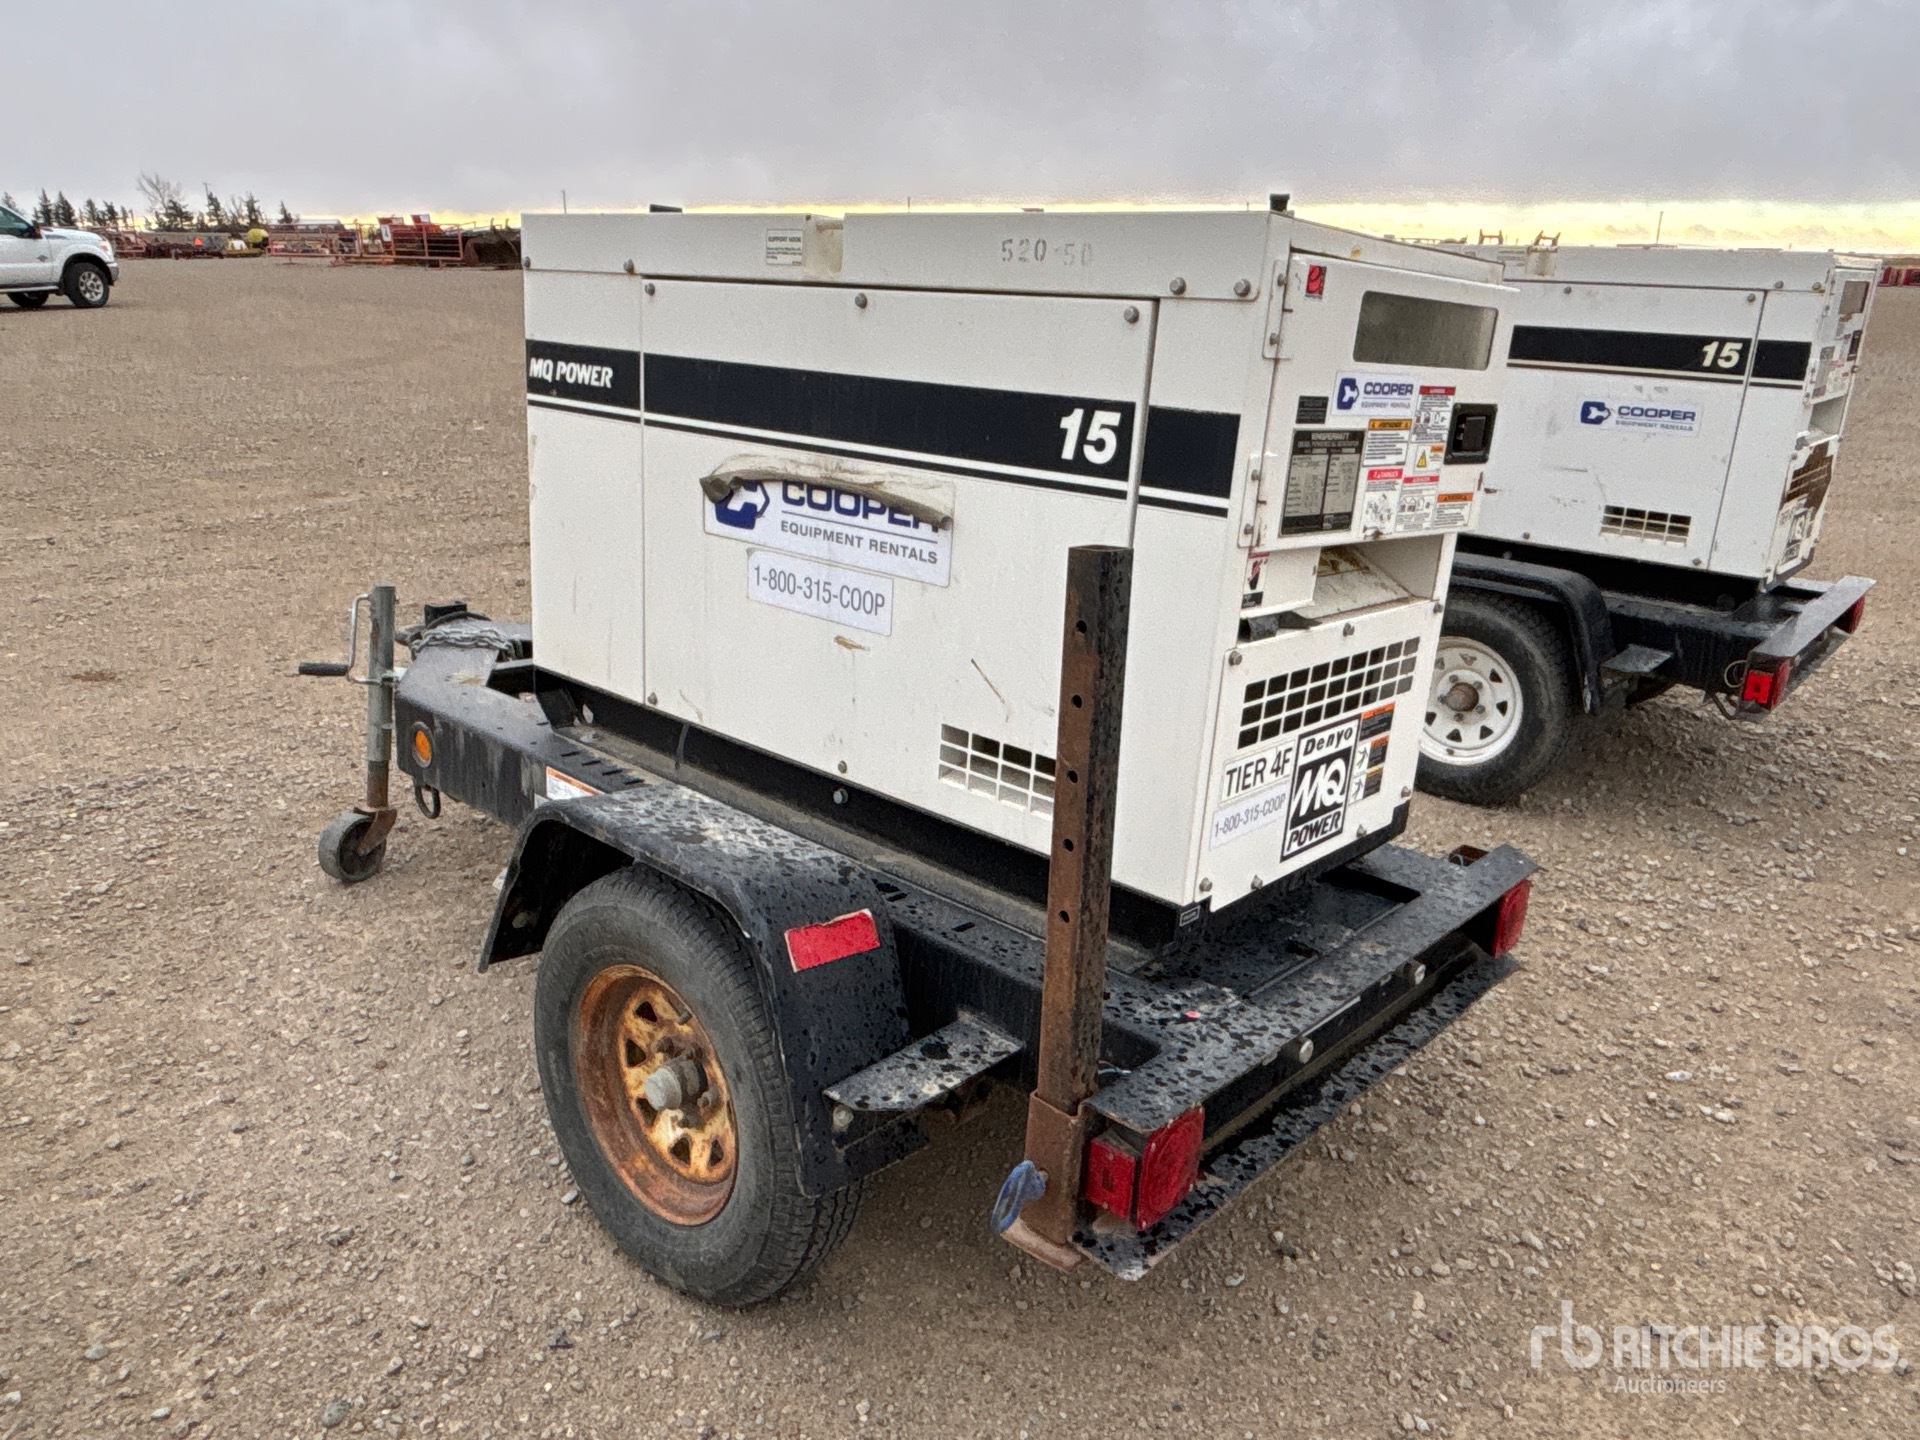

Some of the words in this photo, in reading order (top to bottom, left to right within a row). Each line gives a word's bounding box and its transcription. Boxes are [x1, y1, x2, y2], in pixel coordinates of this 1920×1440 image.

[529, 357, 553, 383] MQ
[555, 360, 614, 388] POWER
[1700, 341, 1744, 369] 15
[1363, 382, 1414, 396] COOPER
[1618, 405, 1696, 422] COOPER
[1060, 408, 1121, 464] 15
[781, 520, 864, 548] EQUIPMENT
[868, 538, 939, 565] RENTALS
[754, 565, 886, 616] 1-800-315-COOP
[1303, 726, 1354, 756] Denyo
[1226, 757, 1268, 797] TIER
[1269, 747, 1293, 779] 4F
[1290, 758, 1346, 818] MQ
[1214, 792, 1287, 838] 1-800-315-COOP
[1287, 811, 1343, 852] POWER
